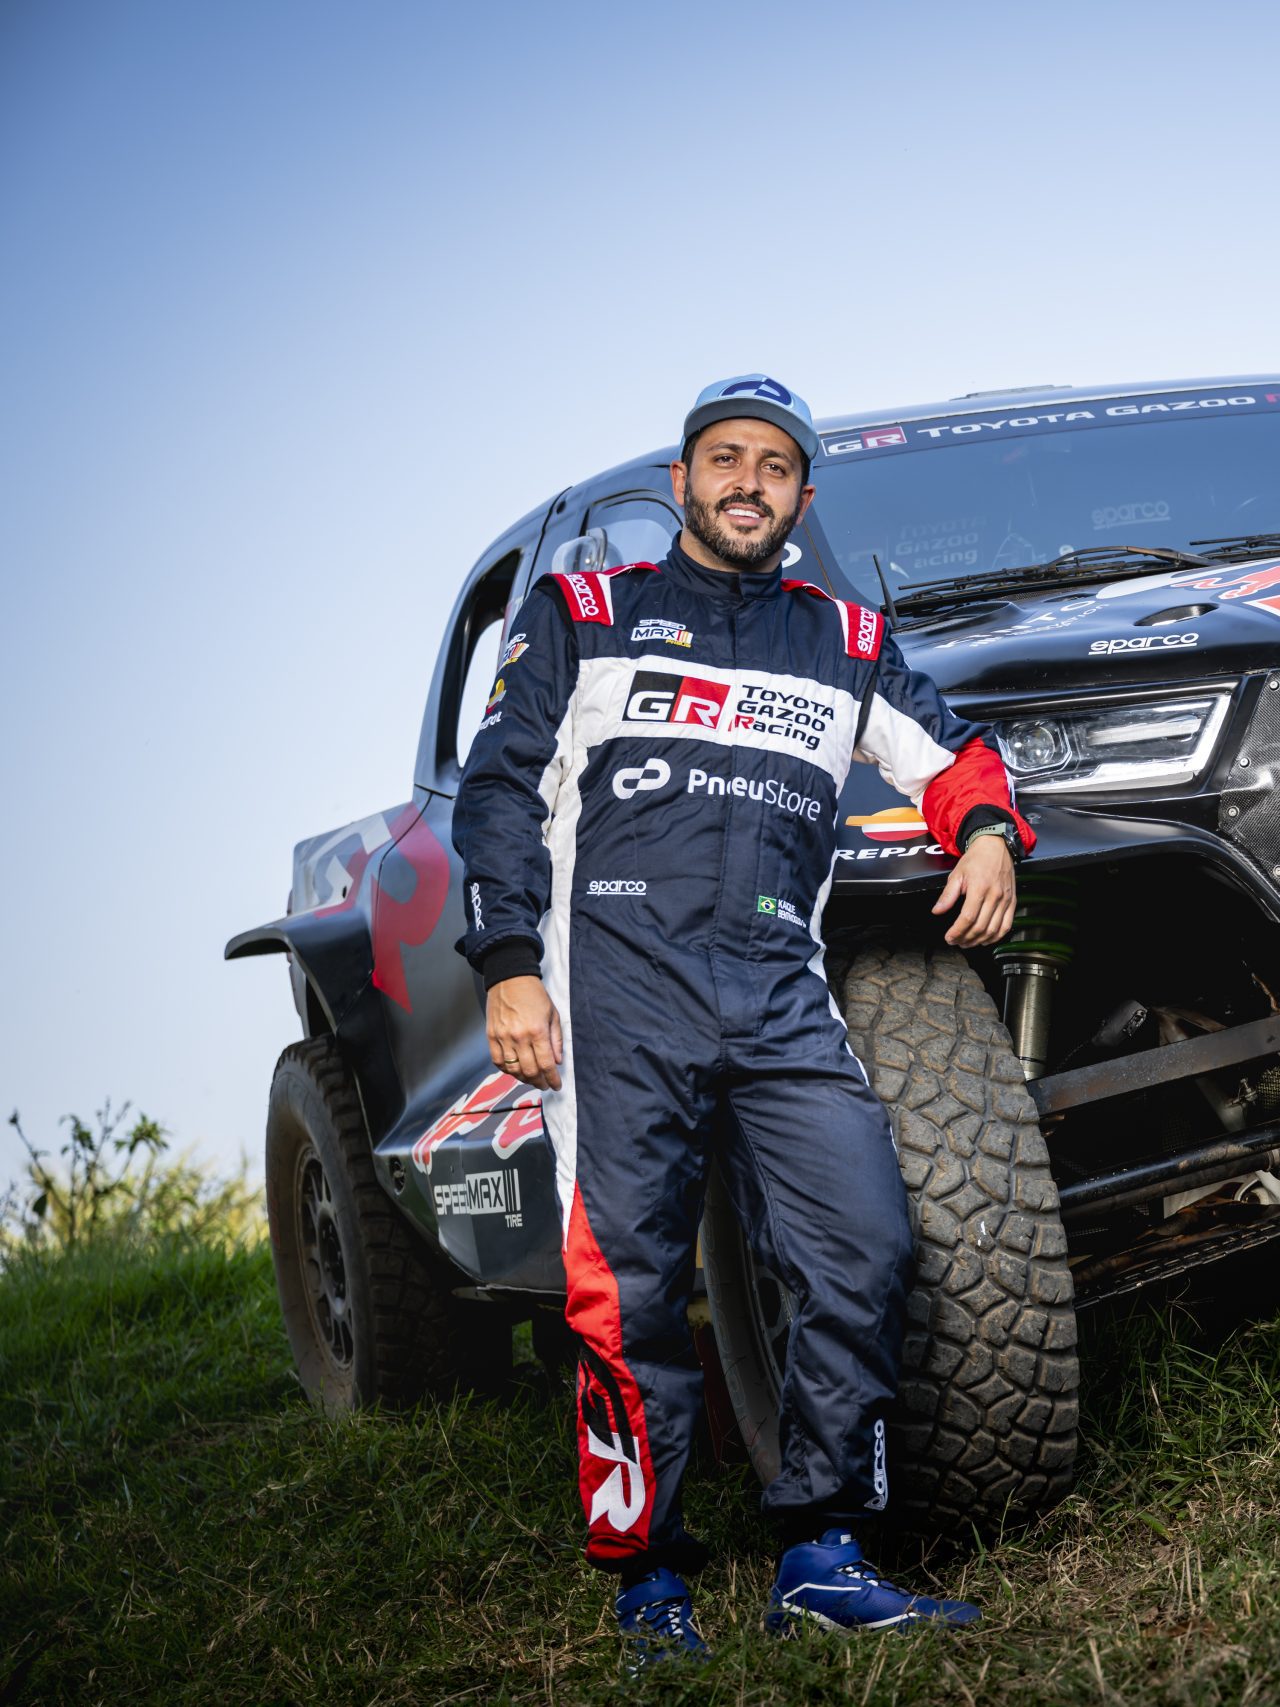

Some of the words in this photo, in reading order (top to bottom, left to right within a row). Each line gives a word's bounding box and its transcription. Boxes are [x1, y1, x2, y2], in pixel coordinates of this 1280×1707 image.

[828, 433, 902, 454] GR
[917, 410, 1096, 438] TOYOTA
[1105, 396, 1256, 418] GAZOO
[565, 573, 599, 618] sparco
[634, 628, 677, 639] MAX
[639, 619, 686, 631] SPEED
[1088, 632, 1200, 656] sparco
[626, 690, 721, 729] GR
[736, 700, 826, 732] GAZOO
[742, 685, 835, 721] TOYOTA
[728, 714, 821, 751] Racing
[687, 768, 821, 822] PneuStore
[834, 844, 945, 860] REPSO
[586, 880, 647, 896] sparco
[470, 882, 485, 932] spar
[467, 1176, 505, 1210] MAX
[863, 1418, 889, 1511] parco
